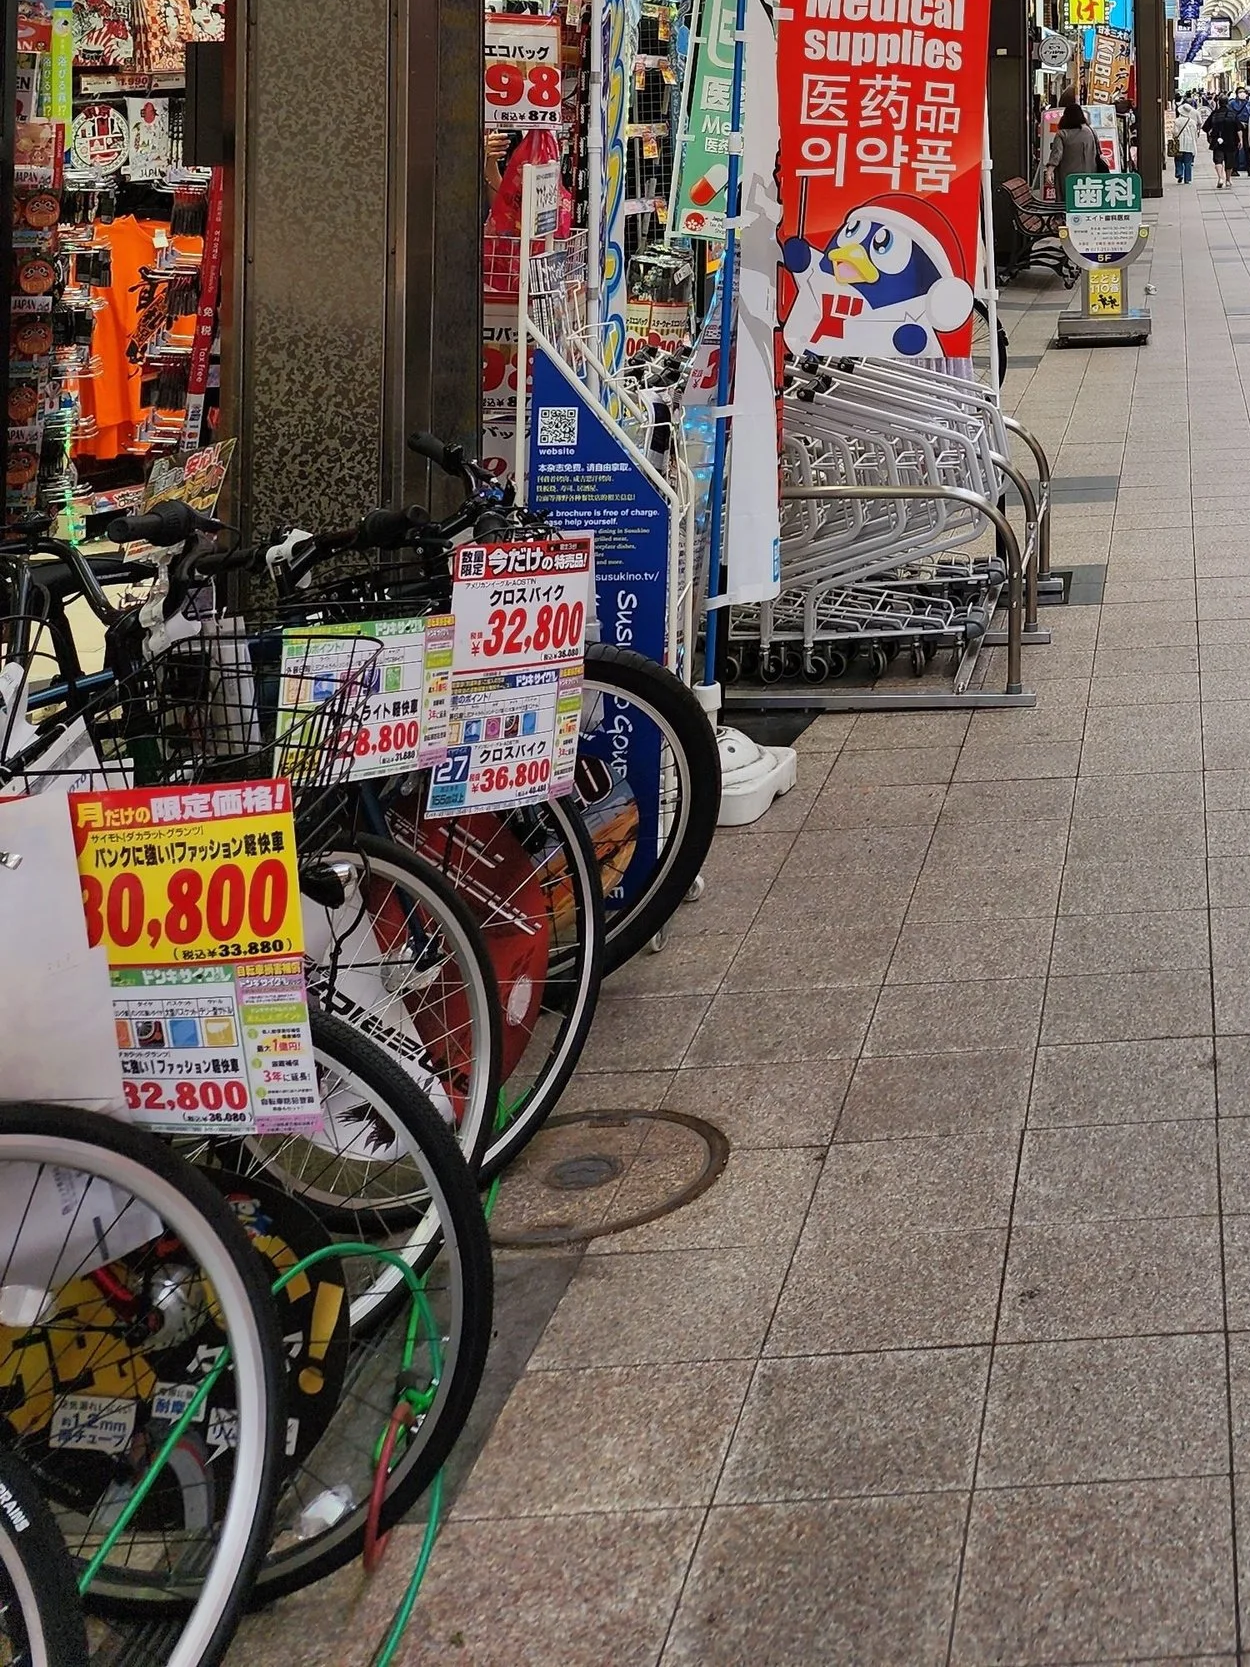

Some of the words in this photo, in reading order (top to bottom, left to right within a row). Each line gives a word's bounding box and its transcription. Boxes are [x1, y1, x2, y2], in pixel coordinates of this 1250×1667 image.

[484, 45, 550, 60] エコバッグ
[804, 29, 963, 71] supplies
[1094, 38, 1115, 88] KOBE
[800, 73, 961, 133] 医药品
[795, 133, 957, 193] 의약품
[1073, 177, 1136, 208] 歯科
[1085, 214, 1131, 222] エイト歯科医院
[1097, 253, 1112, 262] 5F
[538, 447, 576, 455] website
[556, 509, 592, 517] brochure
[594, 509, 601, 517] is
[602, 509, 619, 517] free
[620, 509, 630, 517] of
[630, 509, 660, 519] charge.
[564, 518, 582, 528] help
[584, 517, 619, 528] yourself.
[461, 550, 484, 563] 数量
[488, 546, 588, 575] 今だけの特売品!
[460, 564, 483, 577] 限定
[489, 584, 566, 608] クロスバイク
[479, 740, 547, 765] クロスバイク
[436, 755, 469, 782] 27
[141, 966, 231, 984] ドンキサイクル
